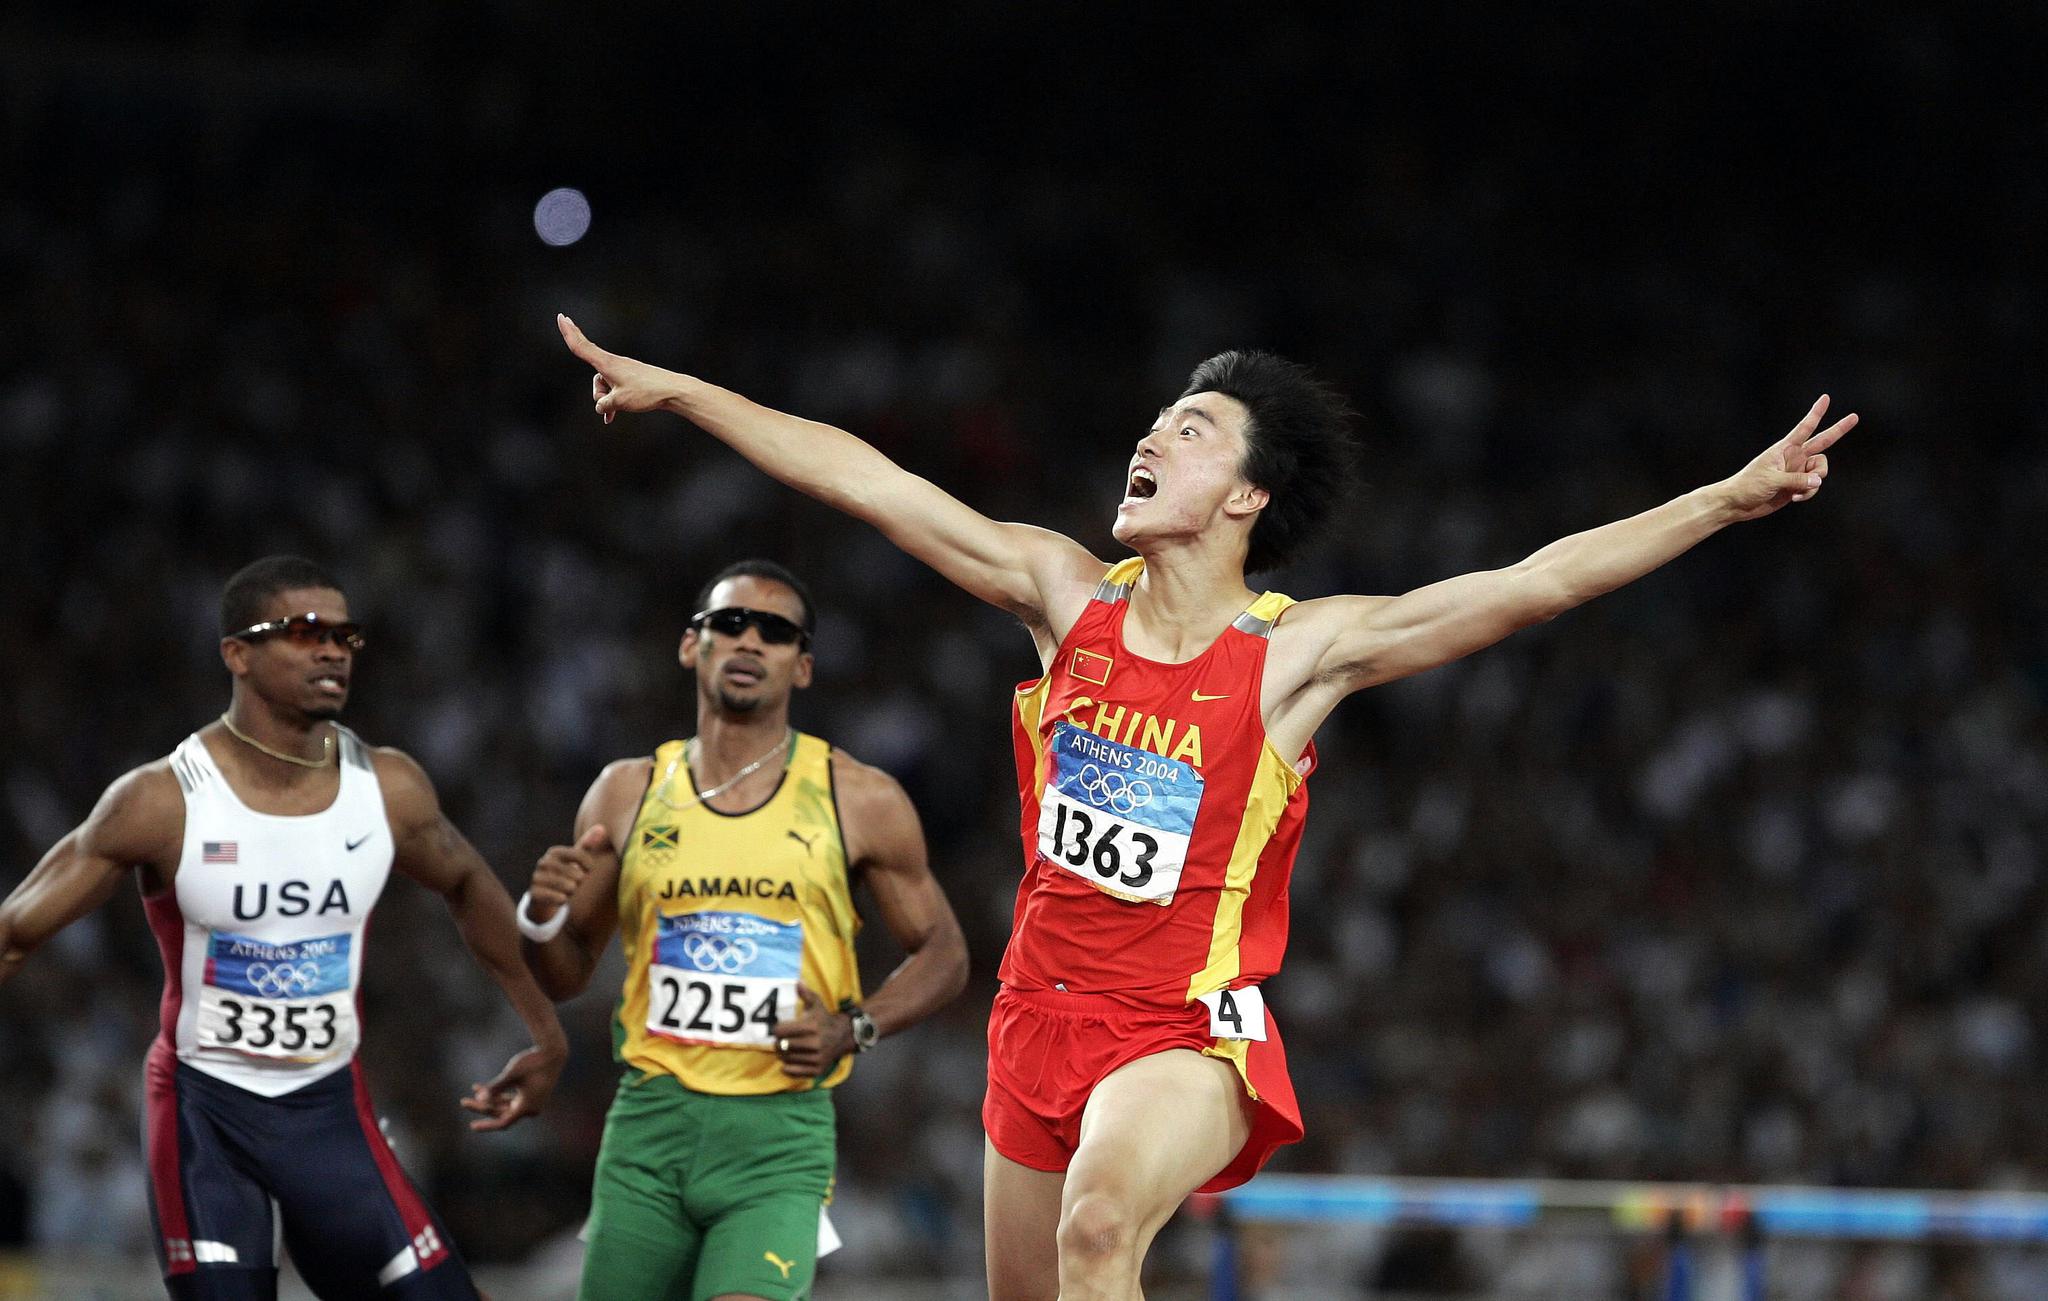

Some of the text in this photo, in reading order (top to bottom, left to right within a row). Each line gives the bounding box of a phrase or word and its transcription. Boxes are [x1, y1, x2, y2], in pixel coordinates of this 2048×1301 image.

[1063, 696, 1202, 768] CHINA
[1071, 734, 1179, 783] ATHENS 2004
[1053, 803, 1159, 888] 1363
[233, 879, 351, 921] USA
[660, 878, 796, 900] JAMAICA
[216, 1000, 336, 1050] 3353
[660, 977, 779, 1036] 2254
[1218, 990, 1242, 1033] 4
